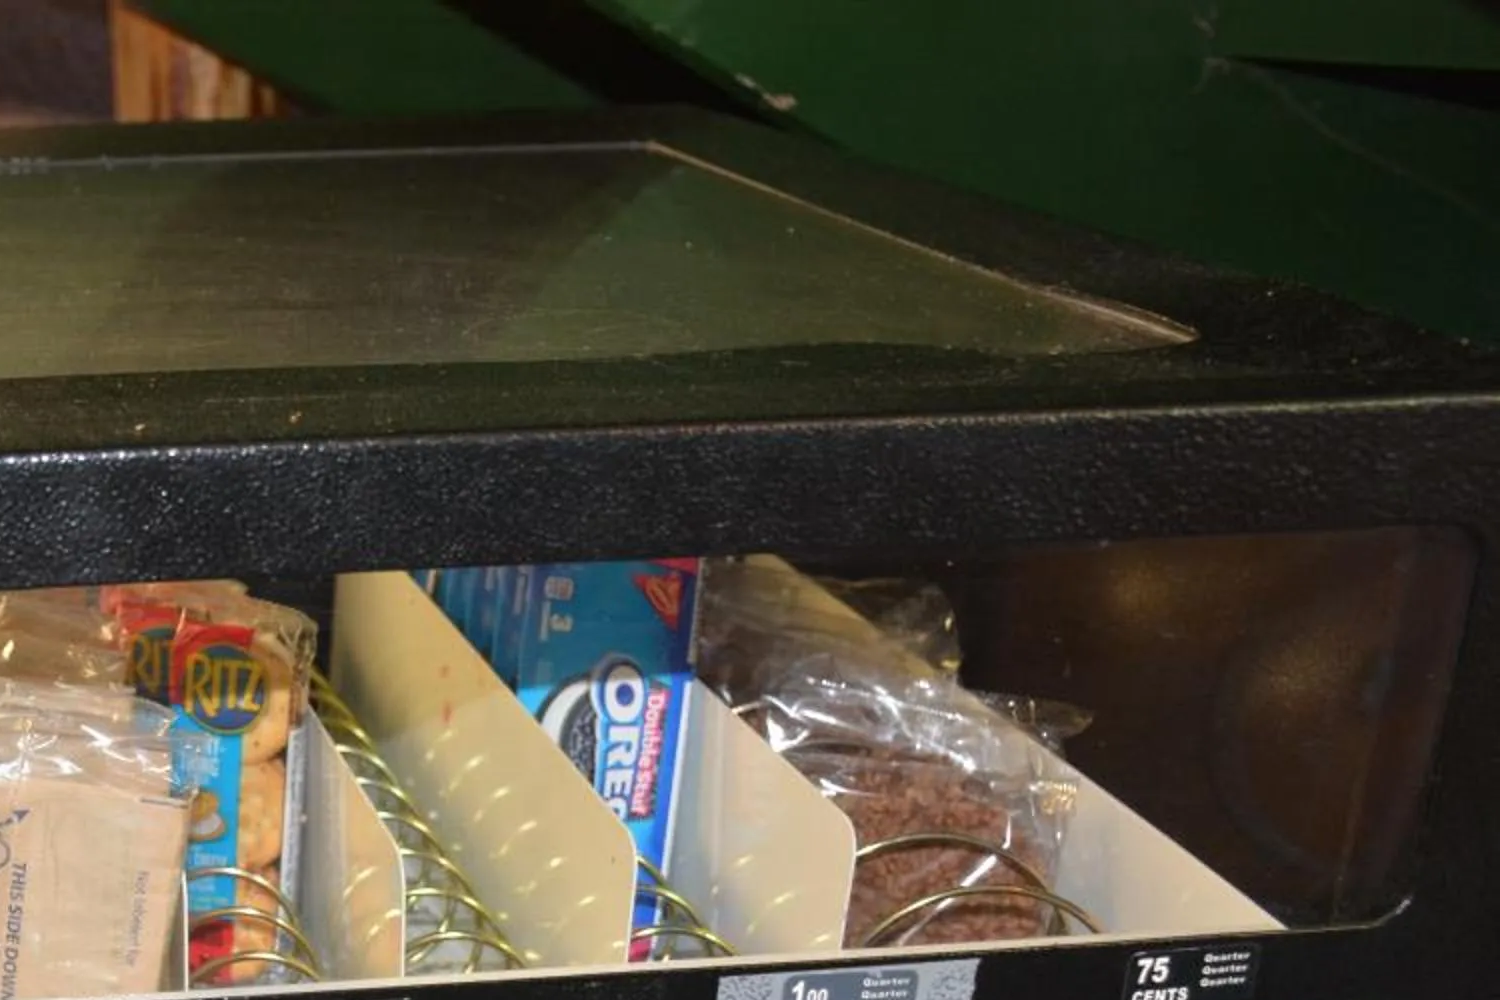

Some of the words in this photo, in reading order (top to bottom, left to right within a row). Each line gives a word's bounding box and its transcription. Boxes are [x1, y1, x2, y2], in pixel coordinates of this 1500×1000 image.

[129, 634, 175, 693] RIT
[184, 652, 265, 718] RITZ
[639, 692, 666, 769] Double
[631, 771, 651, 816] Stuf
[8, 862, 28, 903] THIS
[4, 904, 25, 945] SIDE
[1137, 955, 1171, 985] 75
[1202, 964, 1249, 975] Quarter
[1204, 952, 1250, 963] Quarter
[861, 989, 908, 999] Quarter
[863, 977, 910, 988] Quarter
[1200, 976, 1246, 987] Quarter
